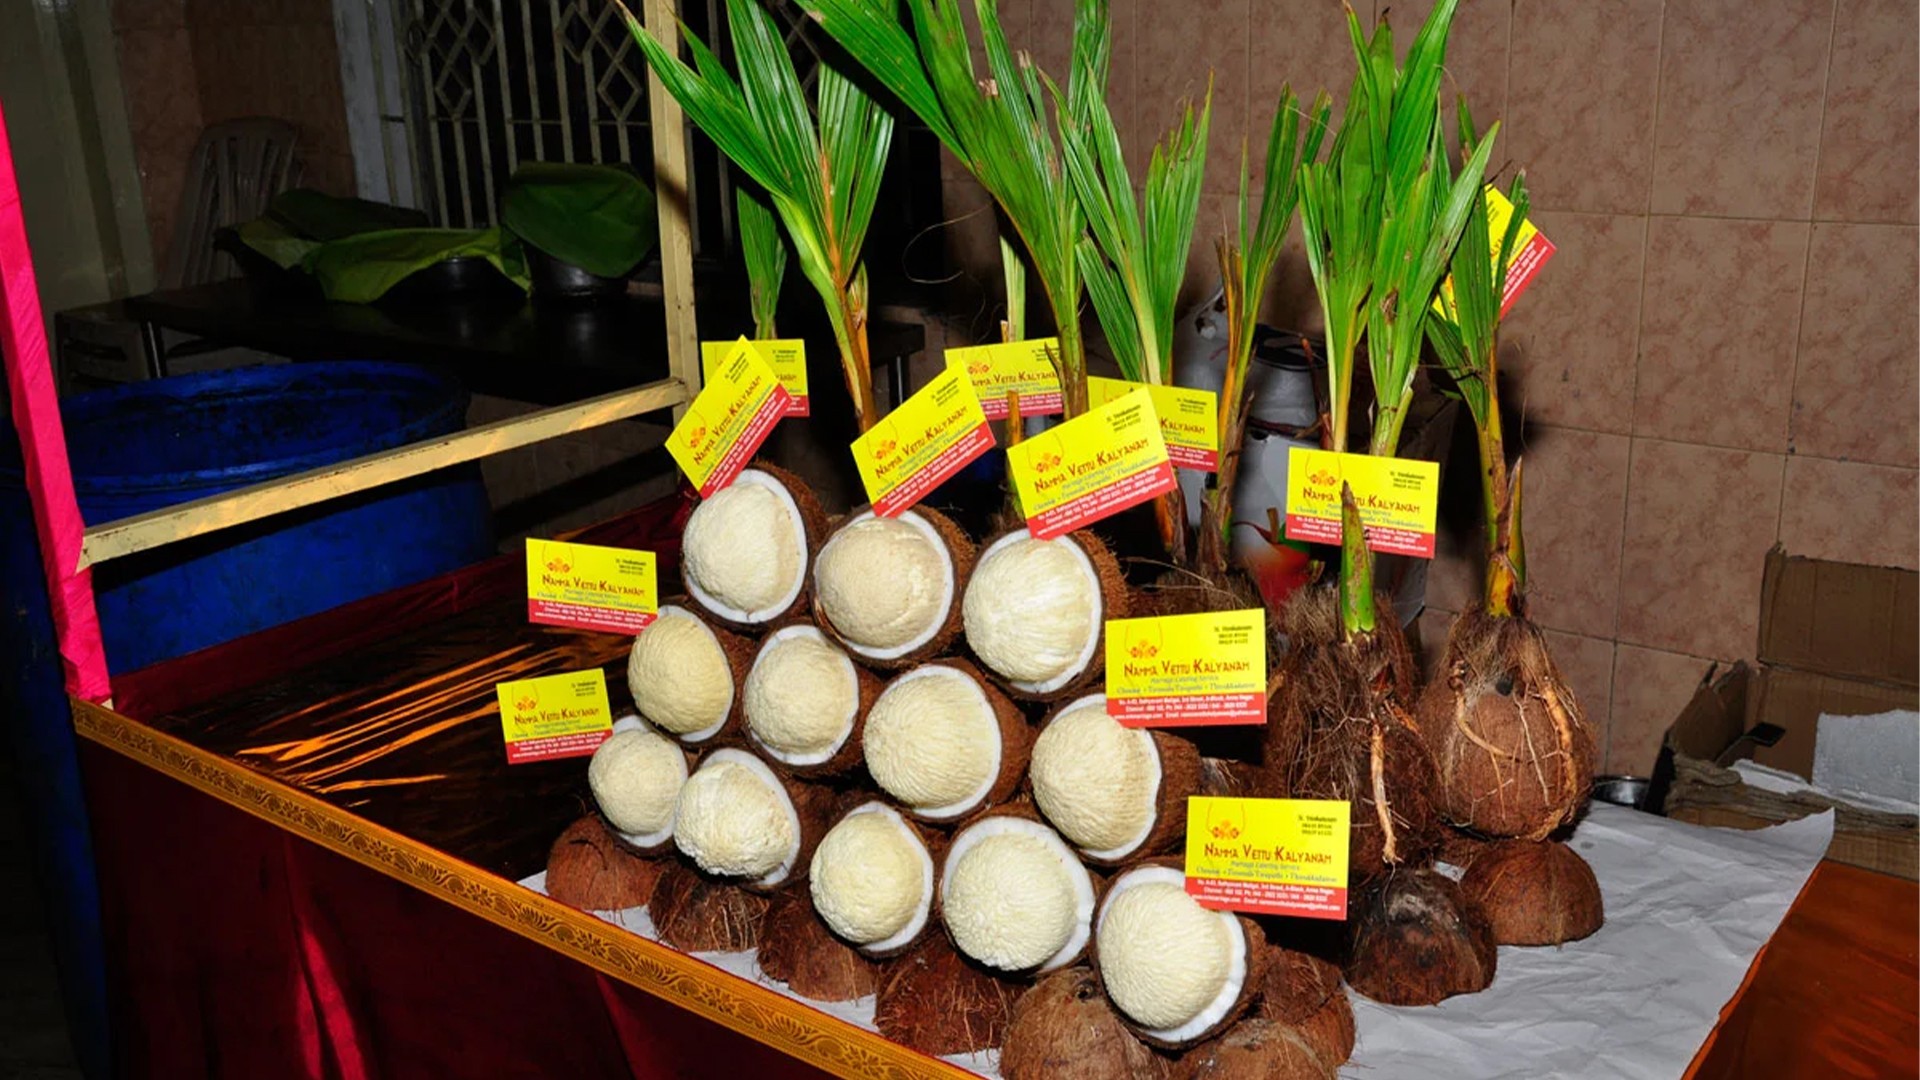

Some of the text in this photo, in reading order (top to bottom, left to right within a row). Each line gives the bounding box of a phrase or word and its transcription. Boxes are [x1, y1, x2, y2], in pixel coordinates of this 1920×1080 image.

[1034, 472, 1066, 493] NAMMA
[1067, 459, 1095, 477] VETTU
[1095, 436, 1148, 466] KALYANAM
[1303, 486, 1334, 501] NAMMA
[1368, 494, 1420, 513] KALYANAM
[1124, 659, 1249, 676] NAMMA VETTU KALYANAM
[1204, 842, 1331, 864] NAMMA VETTU KALYANAM
